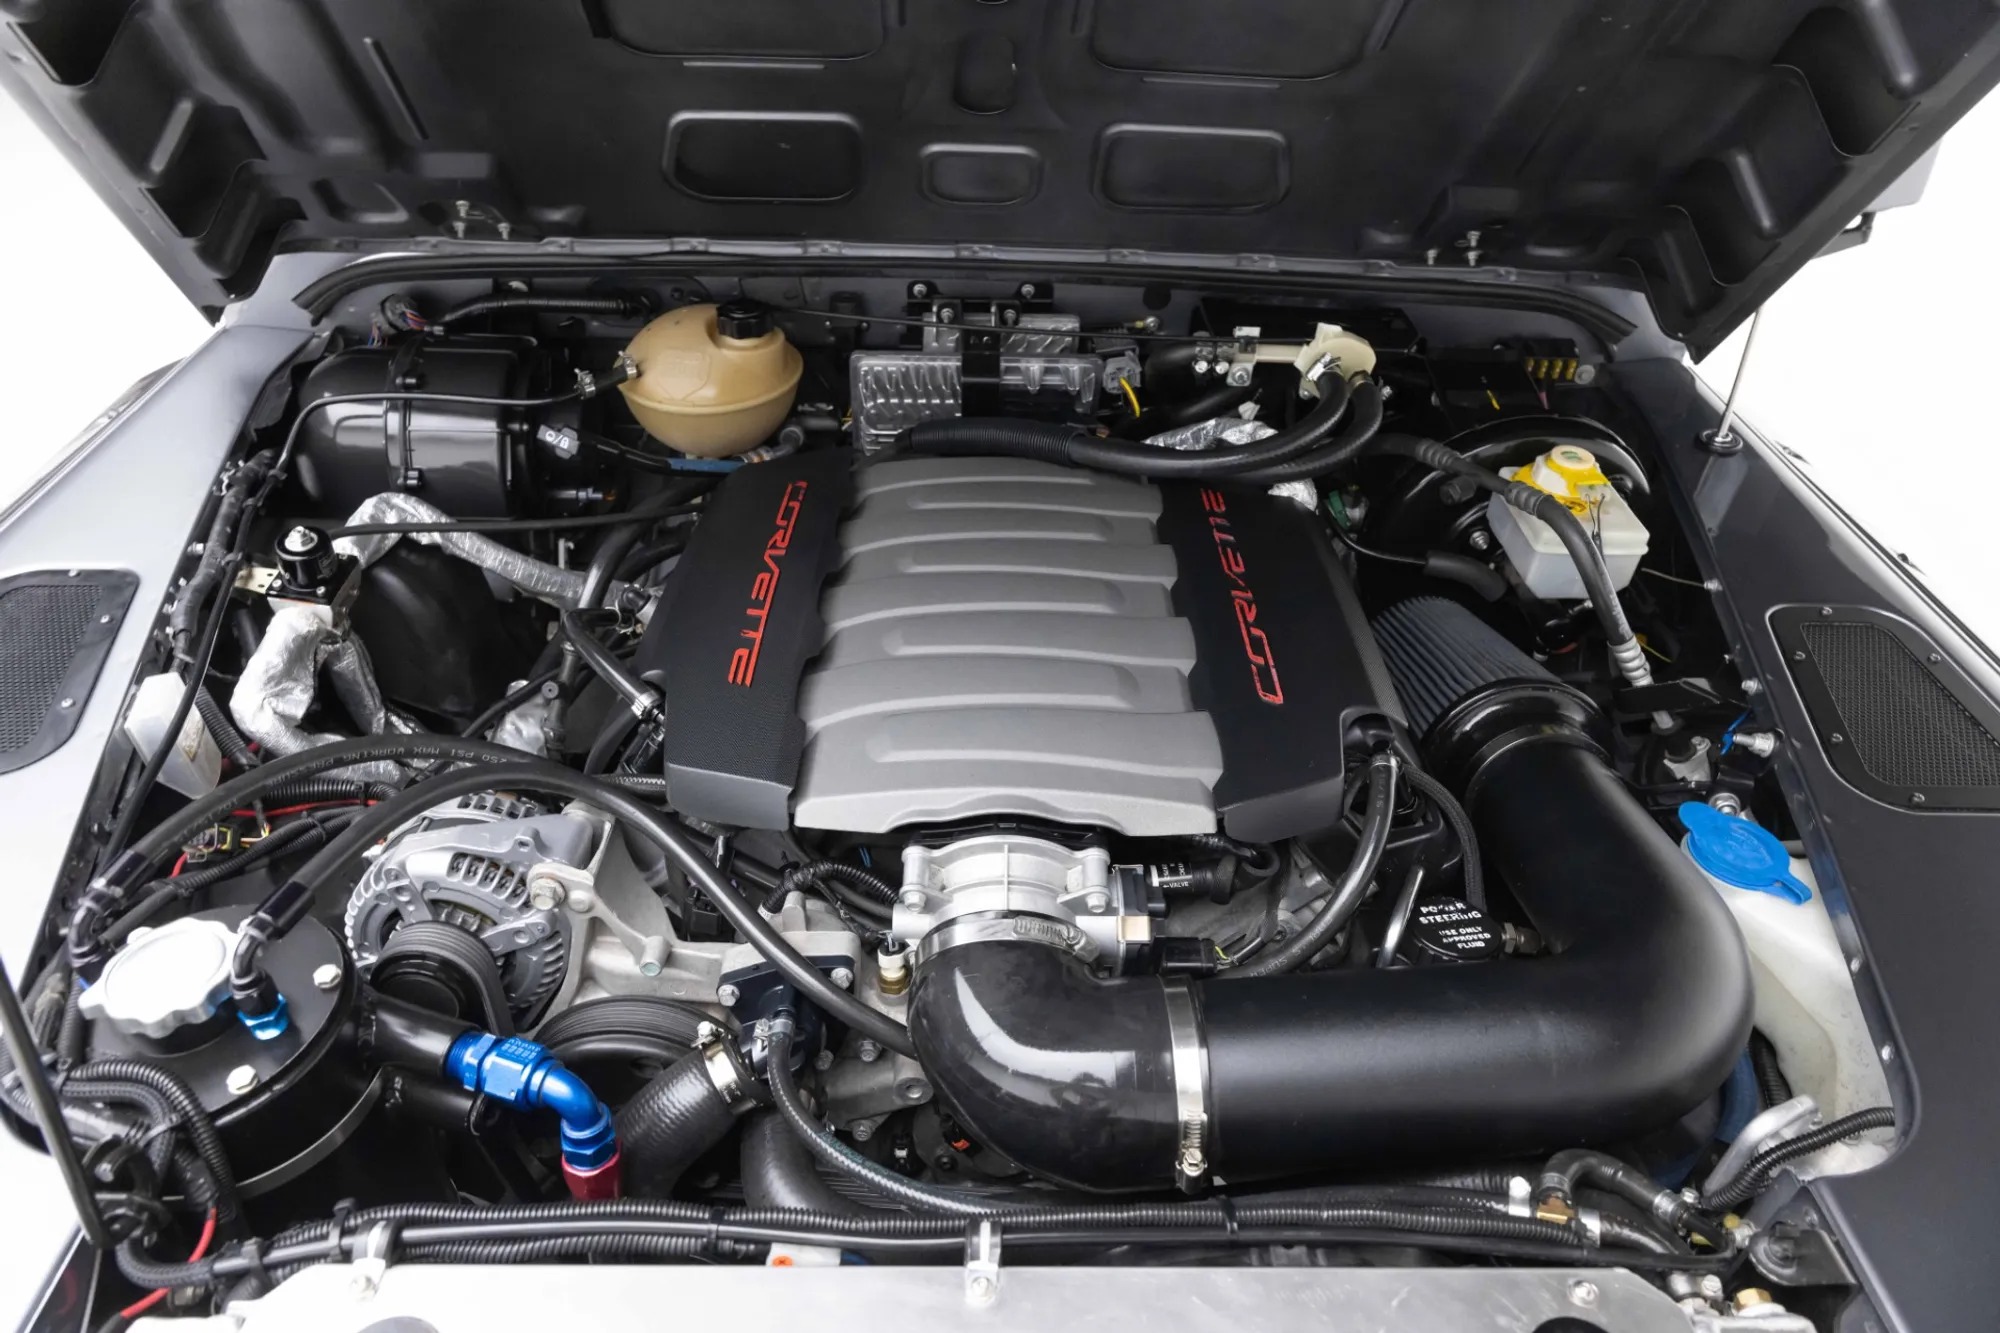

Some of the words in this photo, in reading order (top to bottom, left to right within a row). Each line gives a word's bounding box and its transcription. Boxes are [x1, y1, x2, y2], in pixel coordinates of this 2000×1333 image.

[727, 480, 808, 687] CORVETTE
[1200, 487, 1284, 704] CORVETTE
[1419, 910, 1482, 924] STEERING
[1459, 926, 1482, 934] ONLY
